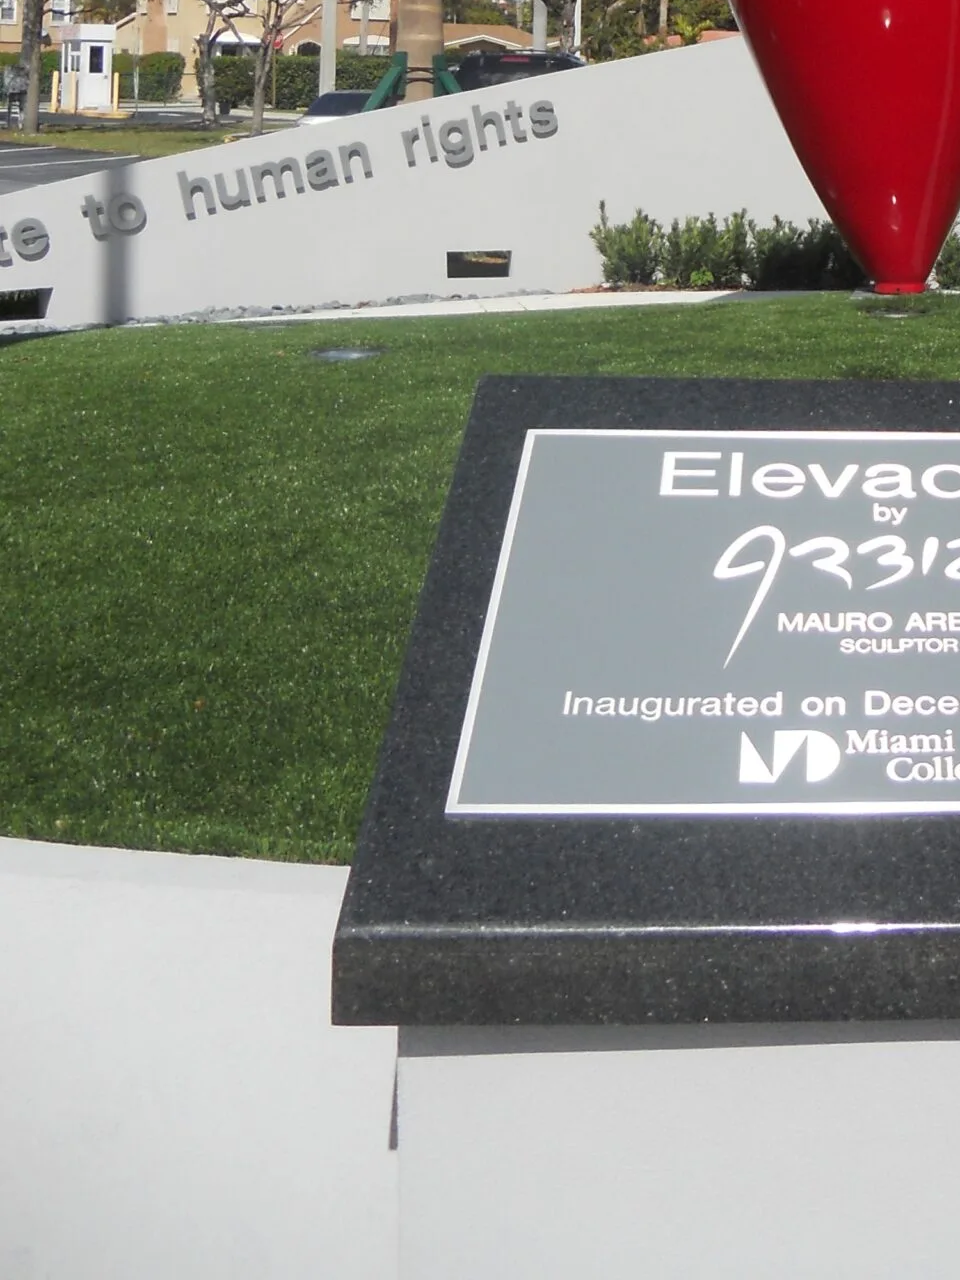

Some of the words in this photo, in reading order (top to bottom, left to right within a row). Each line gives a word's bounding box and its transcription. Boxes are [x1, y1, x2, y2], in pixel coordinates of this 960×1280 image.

[80, 194, 147, 242] to
[176, 140, 374, 221] human
[401, 99, 559, 169] rights
[872, 502, 909, 526] by
[777, 611, 893, 634] MAURO
[839, 637, 960, 655] SCULPTOR
[562, 690, 784, 722] Inaugurated
[800, 696, 847, 718] on
[844, 728, 956, 756] Miami
